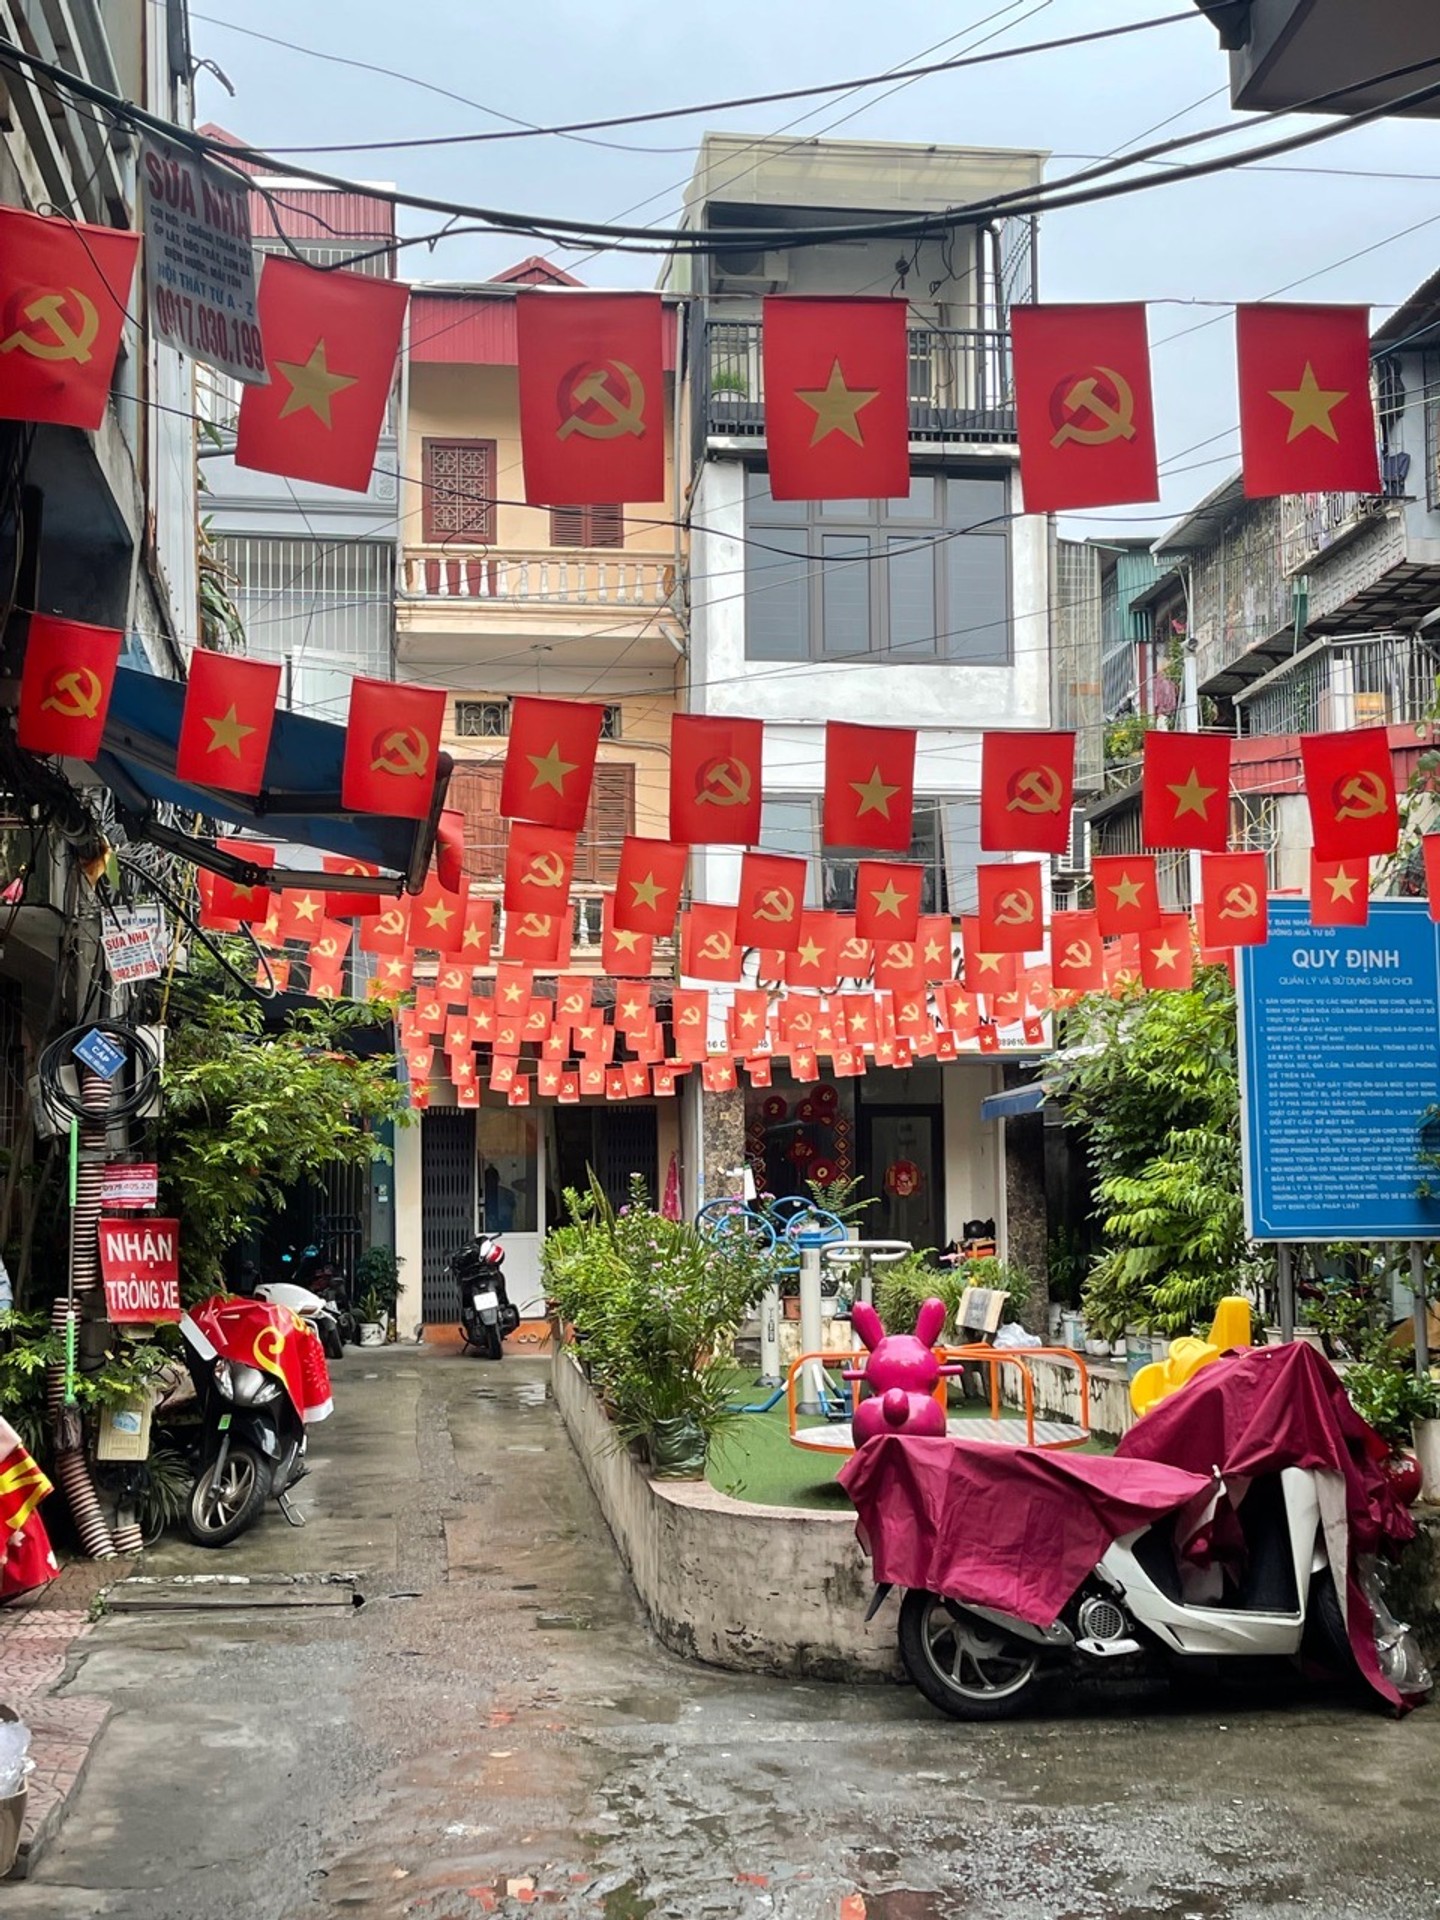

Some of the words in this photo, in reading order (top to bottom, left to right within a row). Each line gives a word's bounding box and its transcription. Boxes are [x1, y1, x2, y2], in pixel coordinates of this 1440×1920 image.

[227, 293, 236, 310] A
[246, 300, 254, 317] Z
[156, 283, 264, 371] 0917.030.199
[1292, 949, 1339, 969] QUY
[1346, 949, 1400, 973] ĐỊNH
[106, 1229, 173, 1269] NHẬN
[106, 1272, 160, 1310] TRÔNG
[161, 1281, 180, 1309] XE
